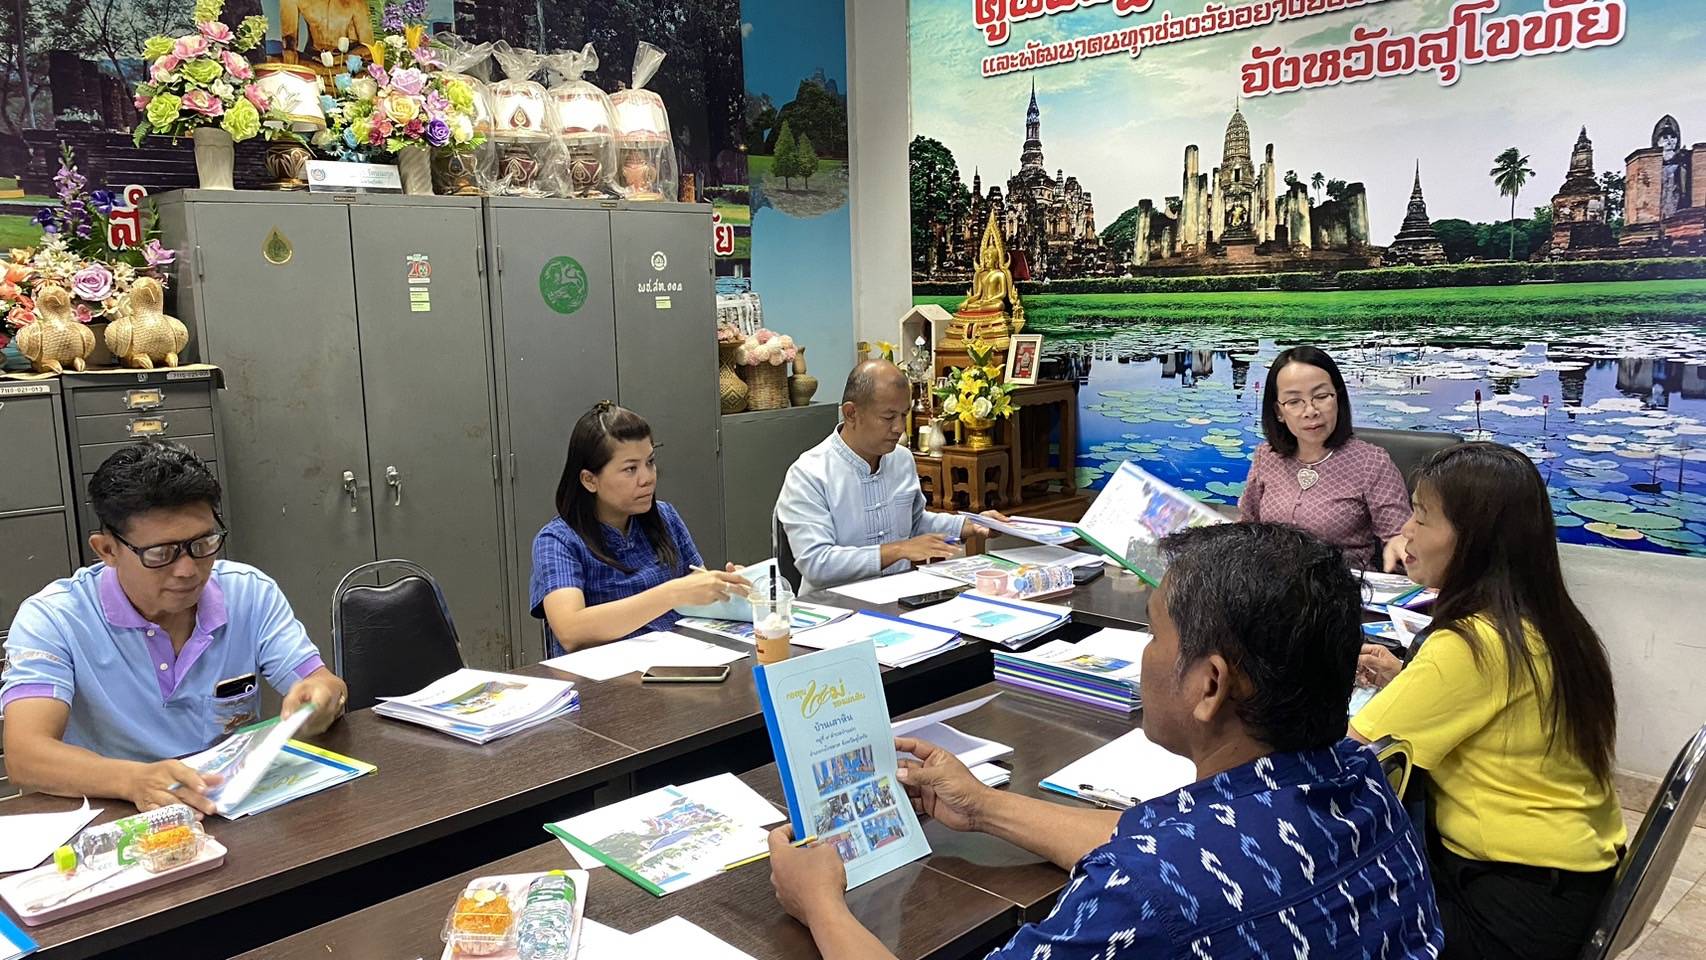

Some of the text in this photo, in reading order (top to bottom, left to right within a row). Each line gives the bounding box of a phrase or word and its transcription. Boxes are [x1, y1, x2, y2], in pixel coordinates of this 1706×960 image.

[1241, 0, 1621, 94] จังหวัดสุโขทัย
